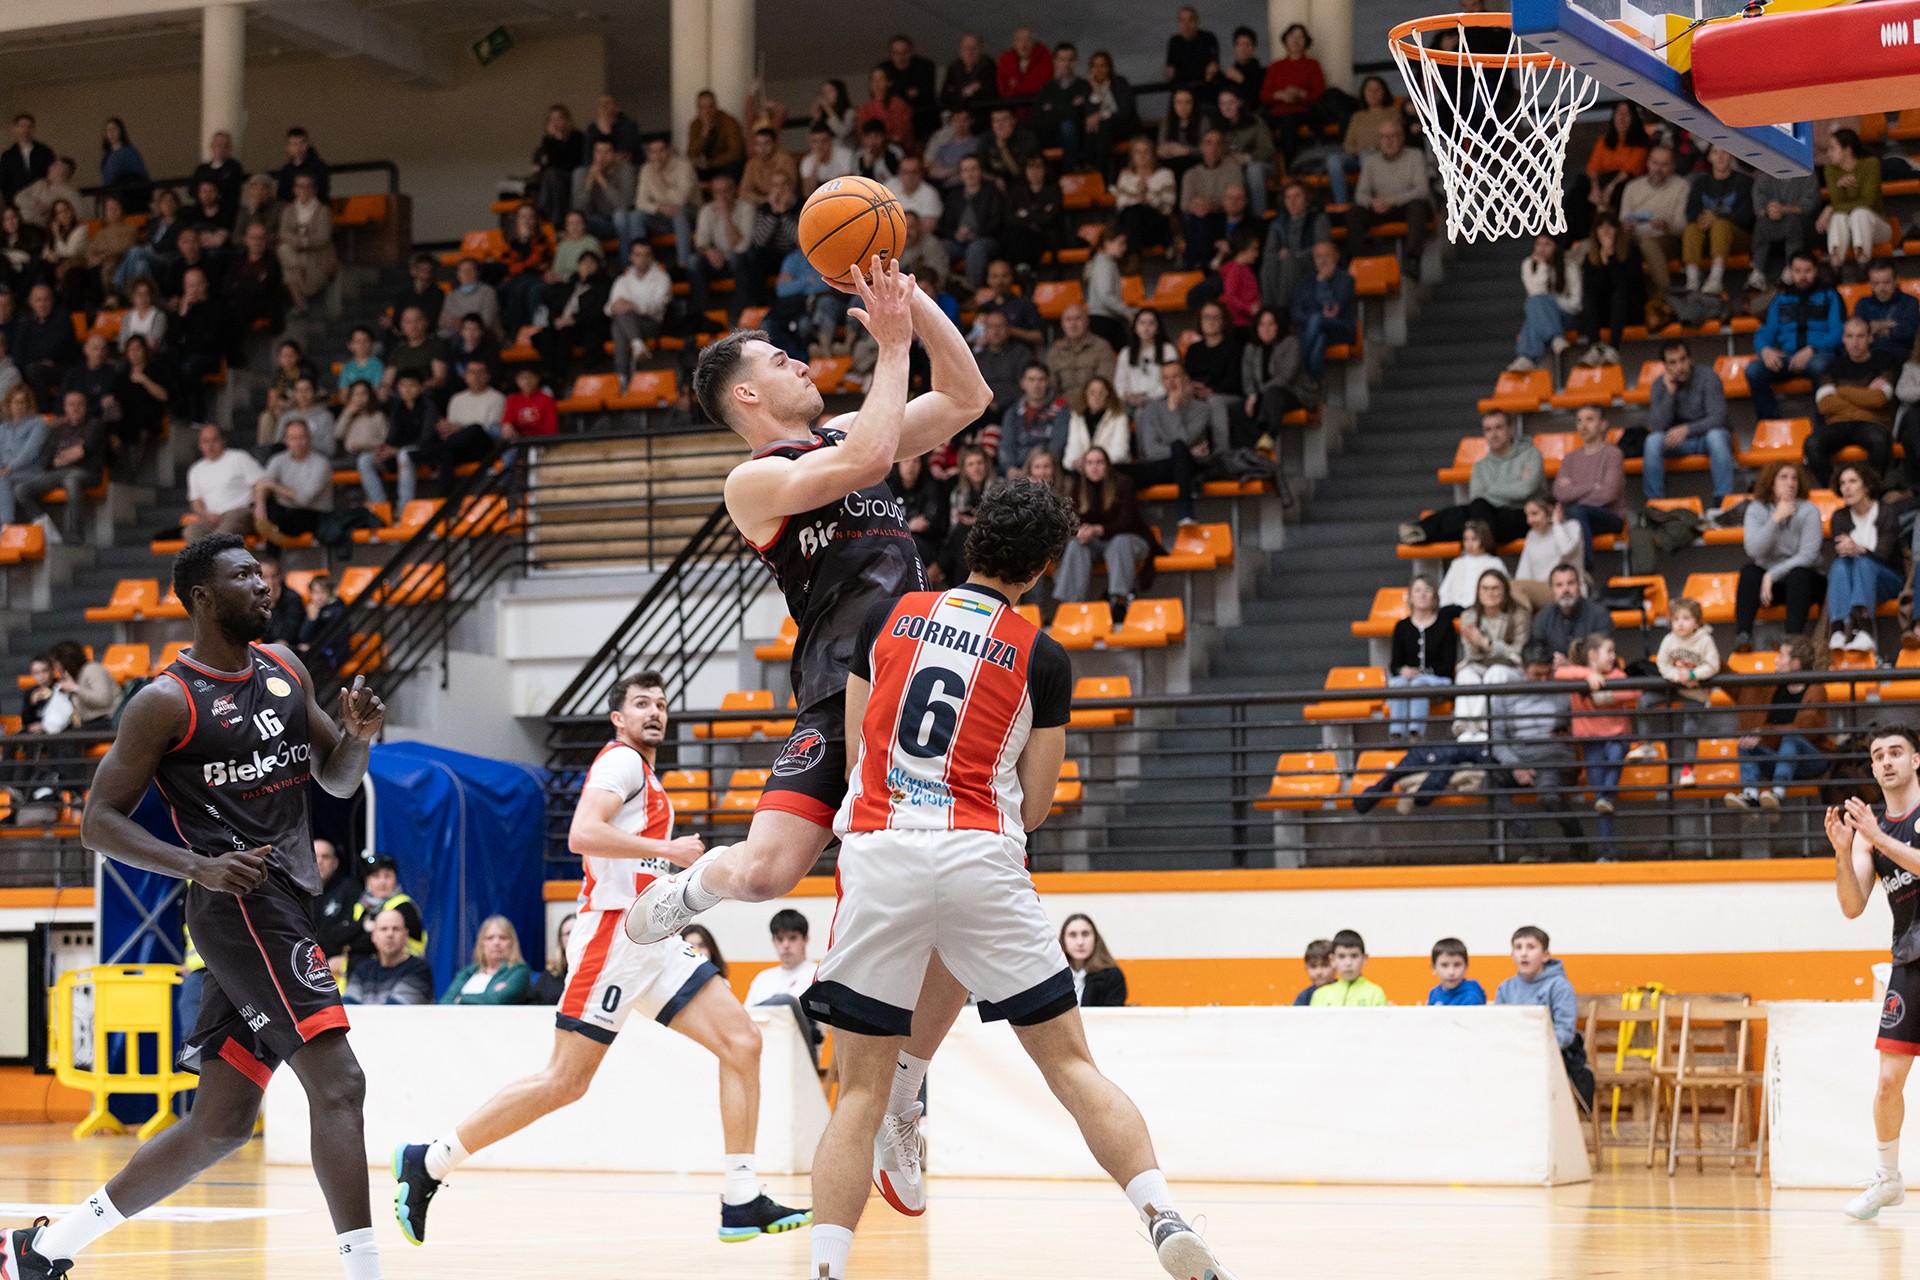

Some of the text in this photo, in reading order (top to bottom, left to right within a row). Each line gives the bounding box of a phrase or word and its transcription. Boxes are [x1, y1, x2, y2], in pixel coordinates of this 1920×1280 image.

[847, 530, 862, 539] FOR
[892, 615, 1018, 672] CORRALIZA
[253, 708, 285, 741] 16
[897, 666, 966, 758] 6
[601, 984, 622, 1013] 0
[90, 1197, 104, 1217] 23
